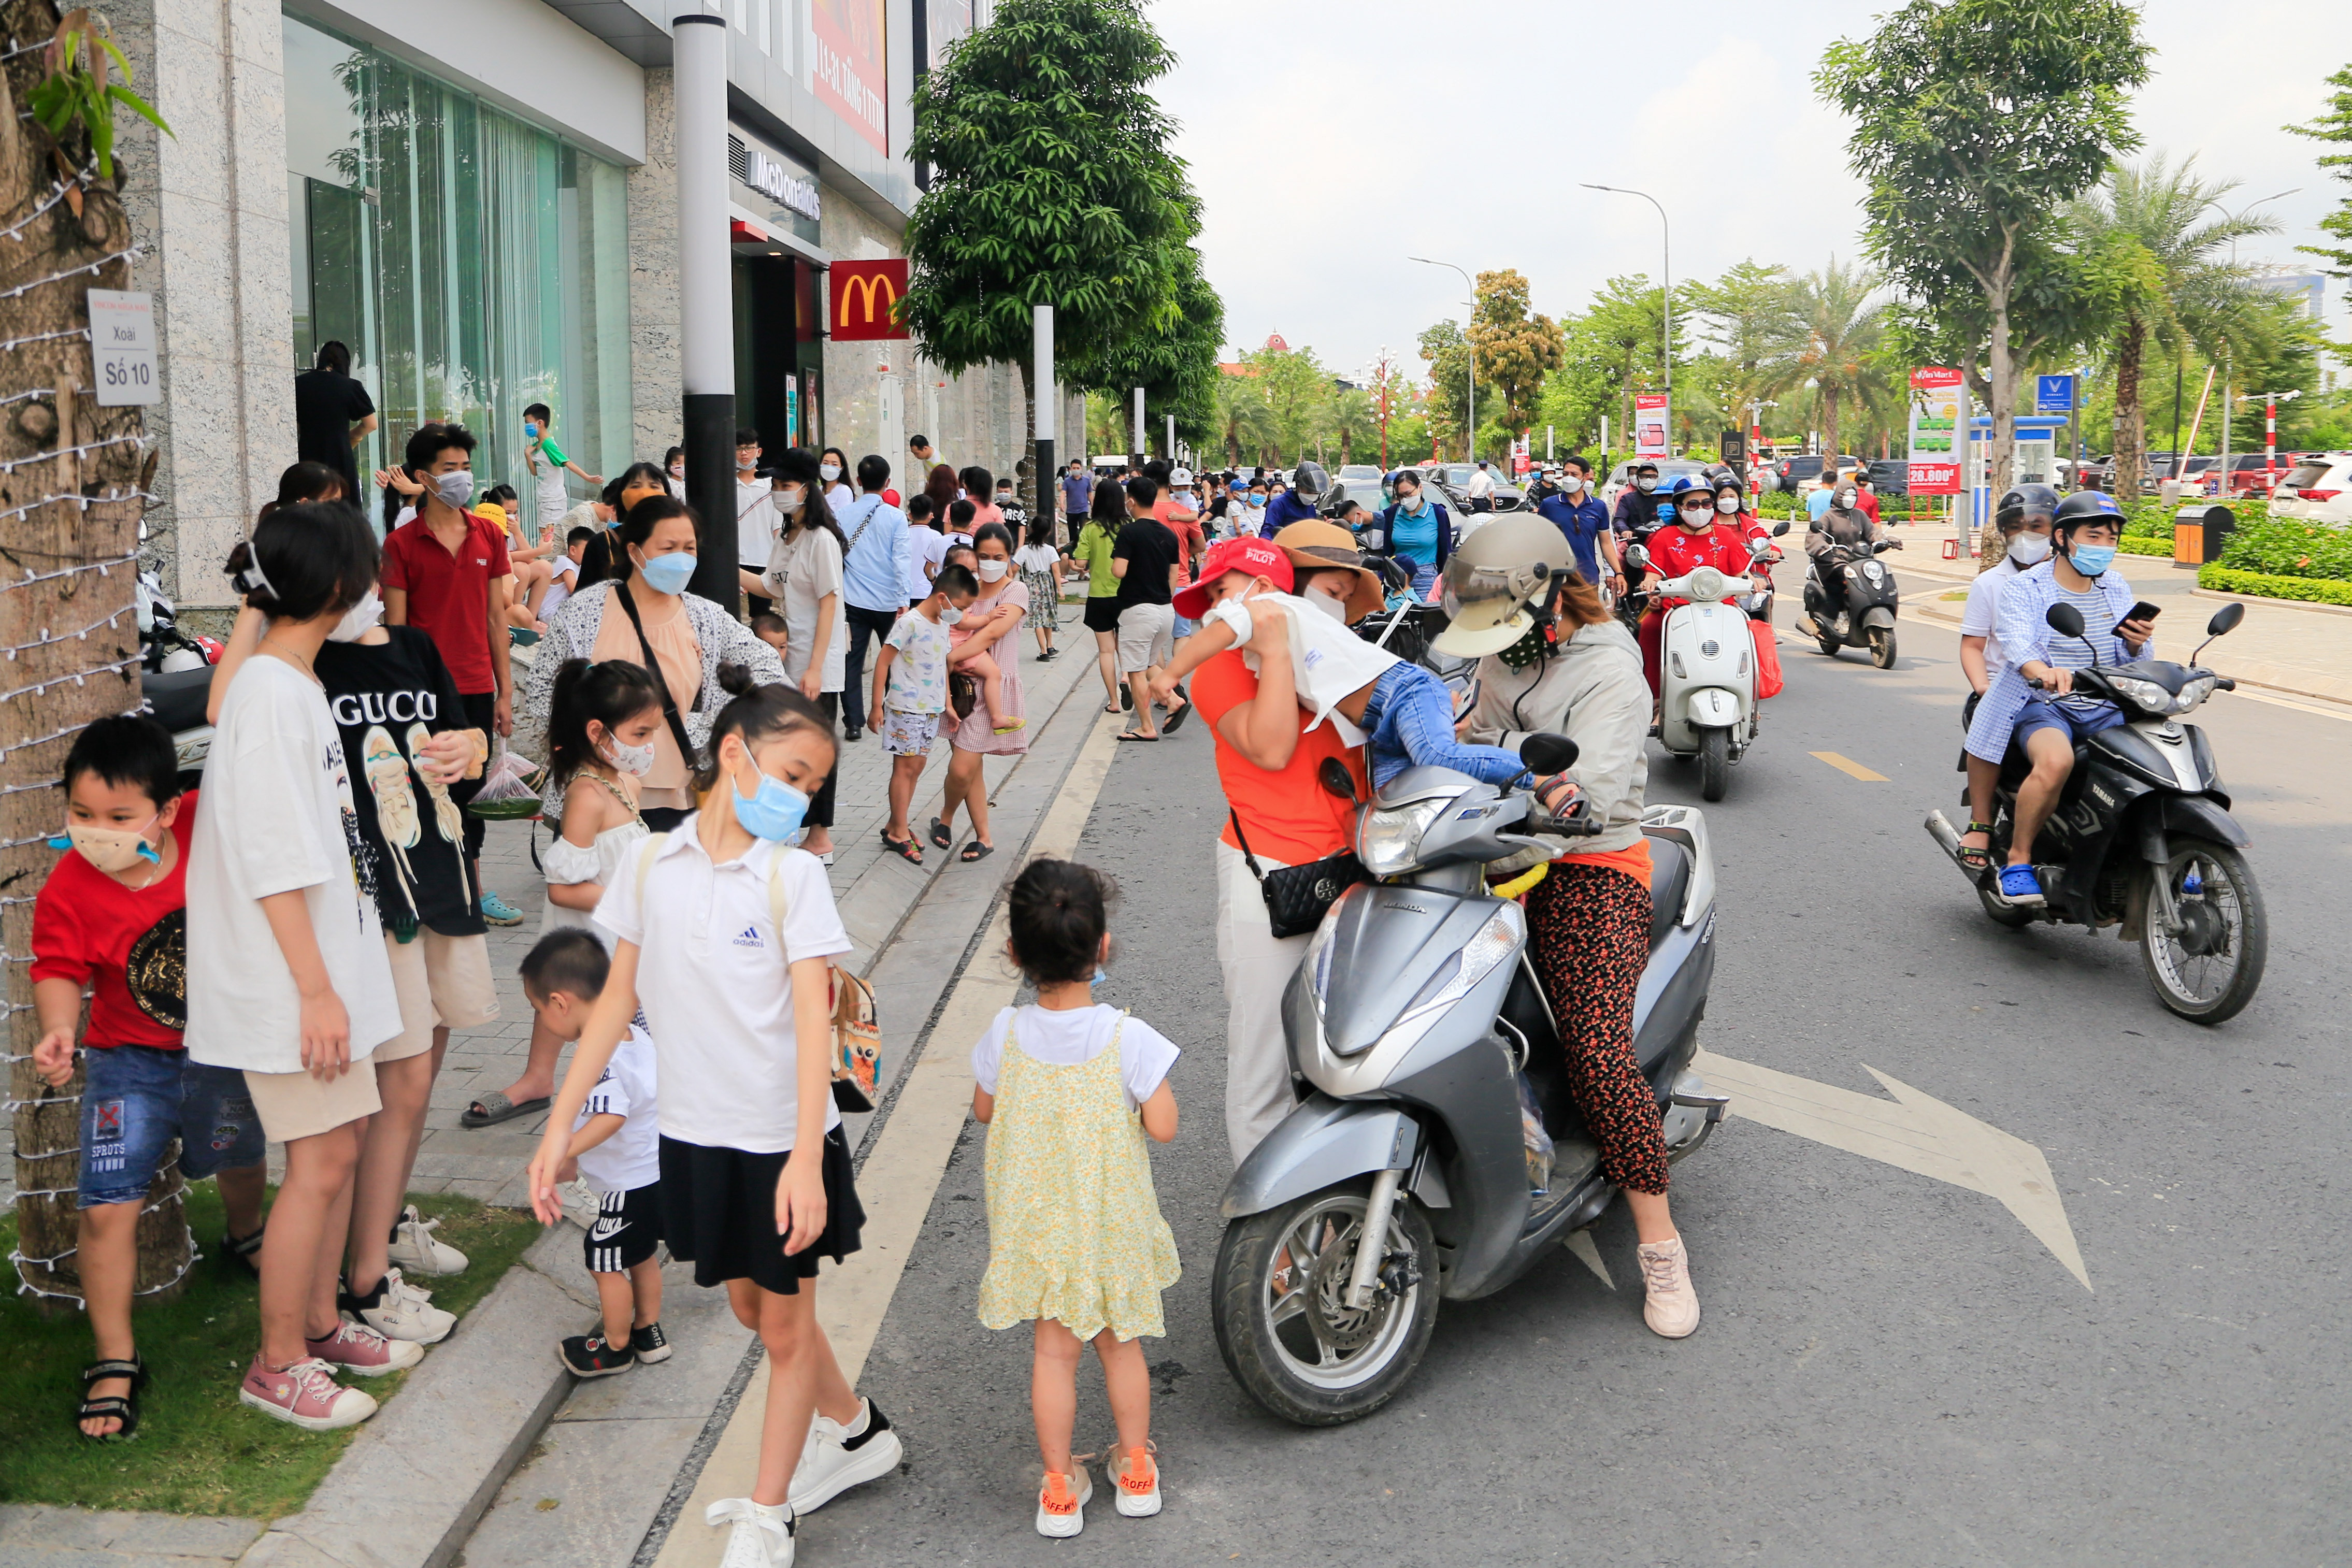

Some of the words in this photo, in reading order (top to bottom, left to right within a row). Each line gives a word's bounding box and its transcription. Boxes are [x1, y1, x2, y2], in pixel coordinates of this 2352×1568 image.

[820, 38, 842, 97] L1-31.
[863, 85, 866, 120] 1
[867, 88, 885, 138] TTTM
[113, 326, 136, 341] Xoài
[106, 357, 127, 385] Số
[132, 363, 149, 385] 10
[1246, 551, 1276, 566] PILOT
[2093, 784, 2115, 808] YAMAHA
[1384, 902, 1426, 913] HONDA
[733, 938, 764, 948] adidas
[92, 1143, 125, 1158] SPROTS
